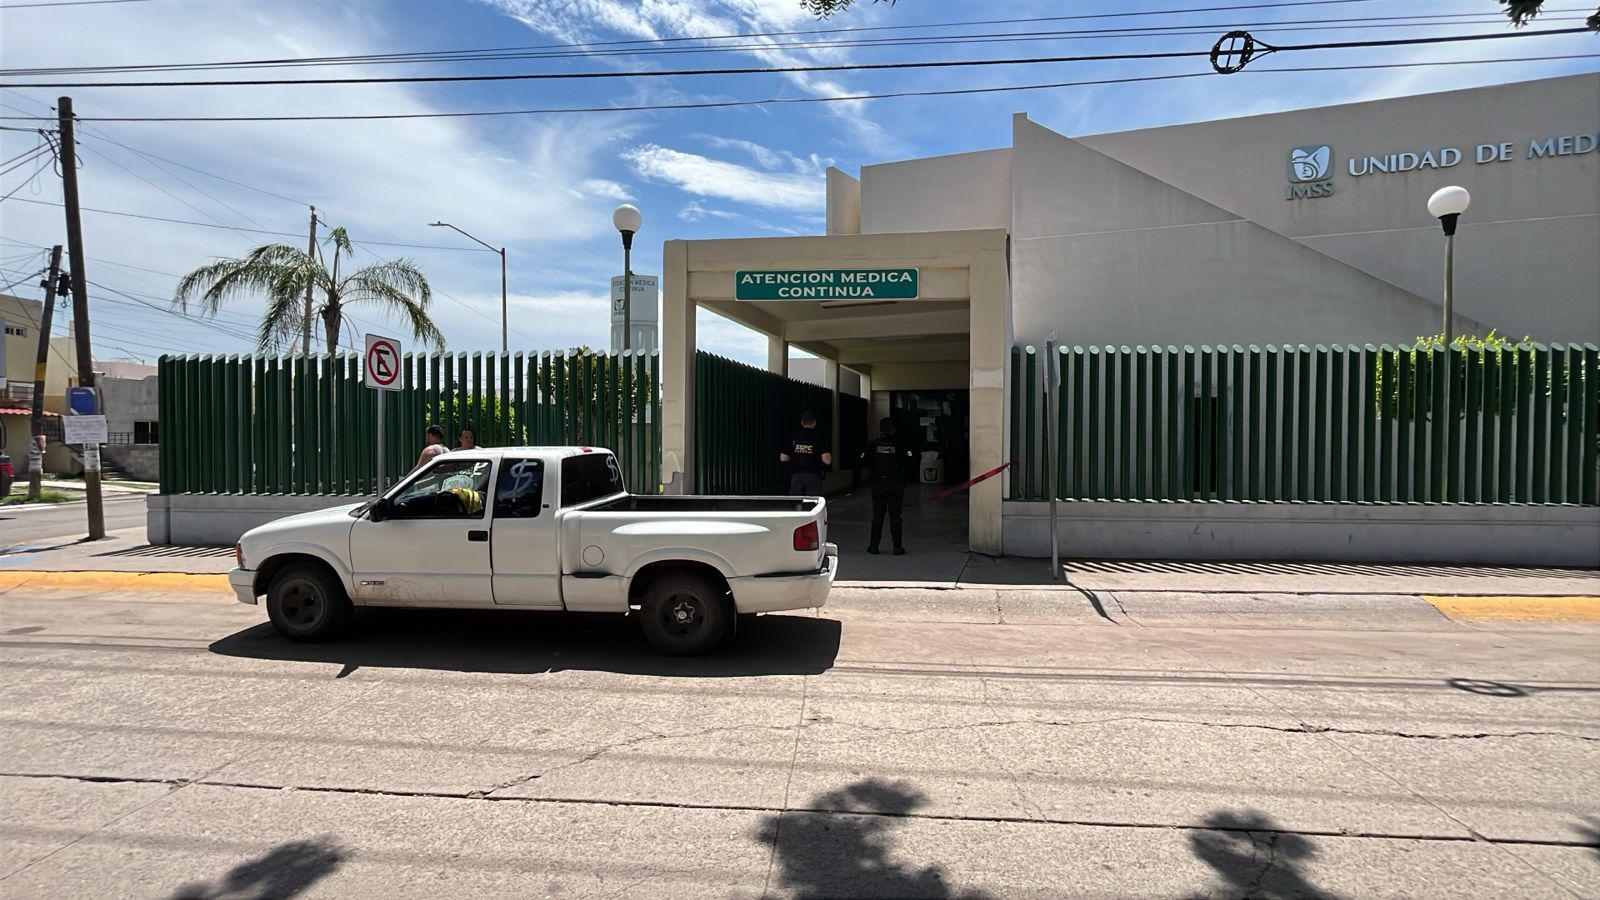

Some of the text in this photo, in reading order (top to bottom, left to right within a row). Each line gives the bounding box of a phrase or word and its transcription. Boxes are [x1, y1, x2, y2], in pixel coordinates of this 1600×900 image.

[1348, 134, 1600, 176] UNIDAD DE MED
[1285, 183, 1334, 200] IMSS
[741, 271, 913, 284] ATENCION MEDICA
[778, 286, 874, 297] CONTINUA
